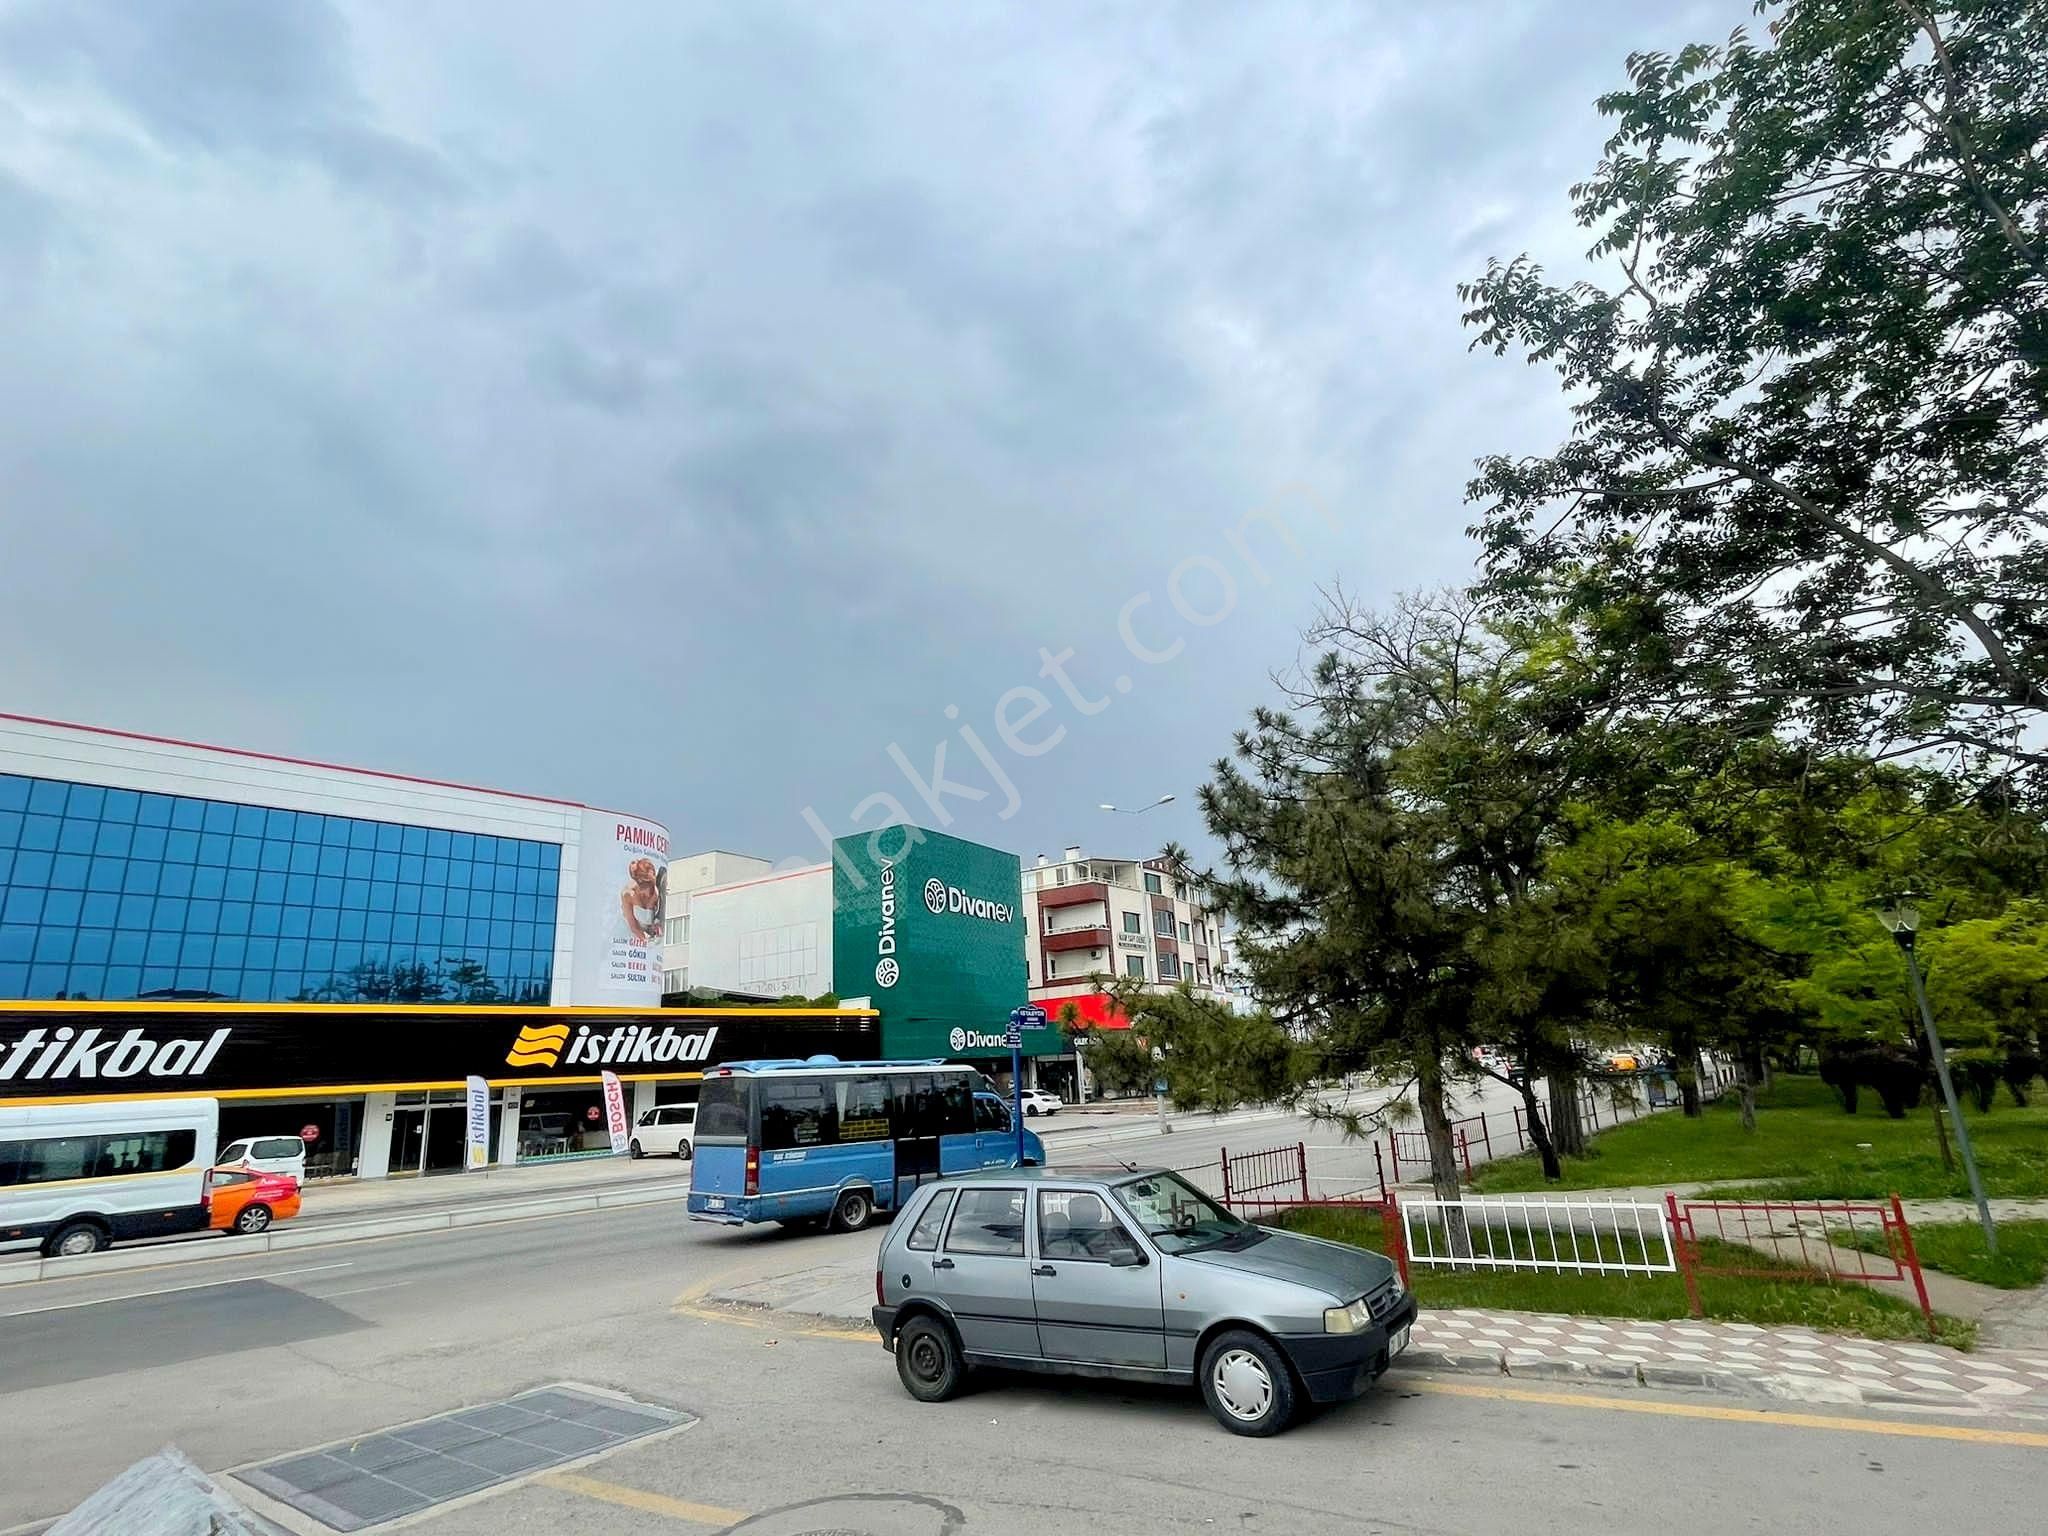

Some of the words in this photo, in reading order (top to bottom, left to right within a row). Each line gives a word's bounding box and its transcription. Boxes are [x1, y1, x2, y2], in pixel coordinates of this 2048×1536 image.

[616, 823, 656, 848] PAMUK
[878, 858, 897, 956] Divanev
[948, 886, 1015, 924] Divanev
[0, 1026, 232, 1080] tikbal
[565, 1025, 719, 1065] istikbal
[966, 1030, 1007, 1048] Divane
[471, 1089, 485, 1144] istikbal
